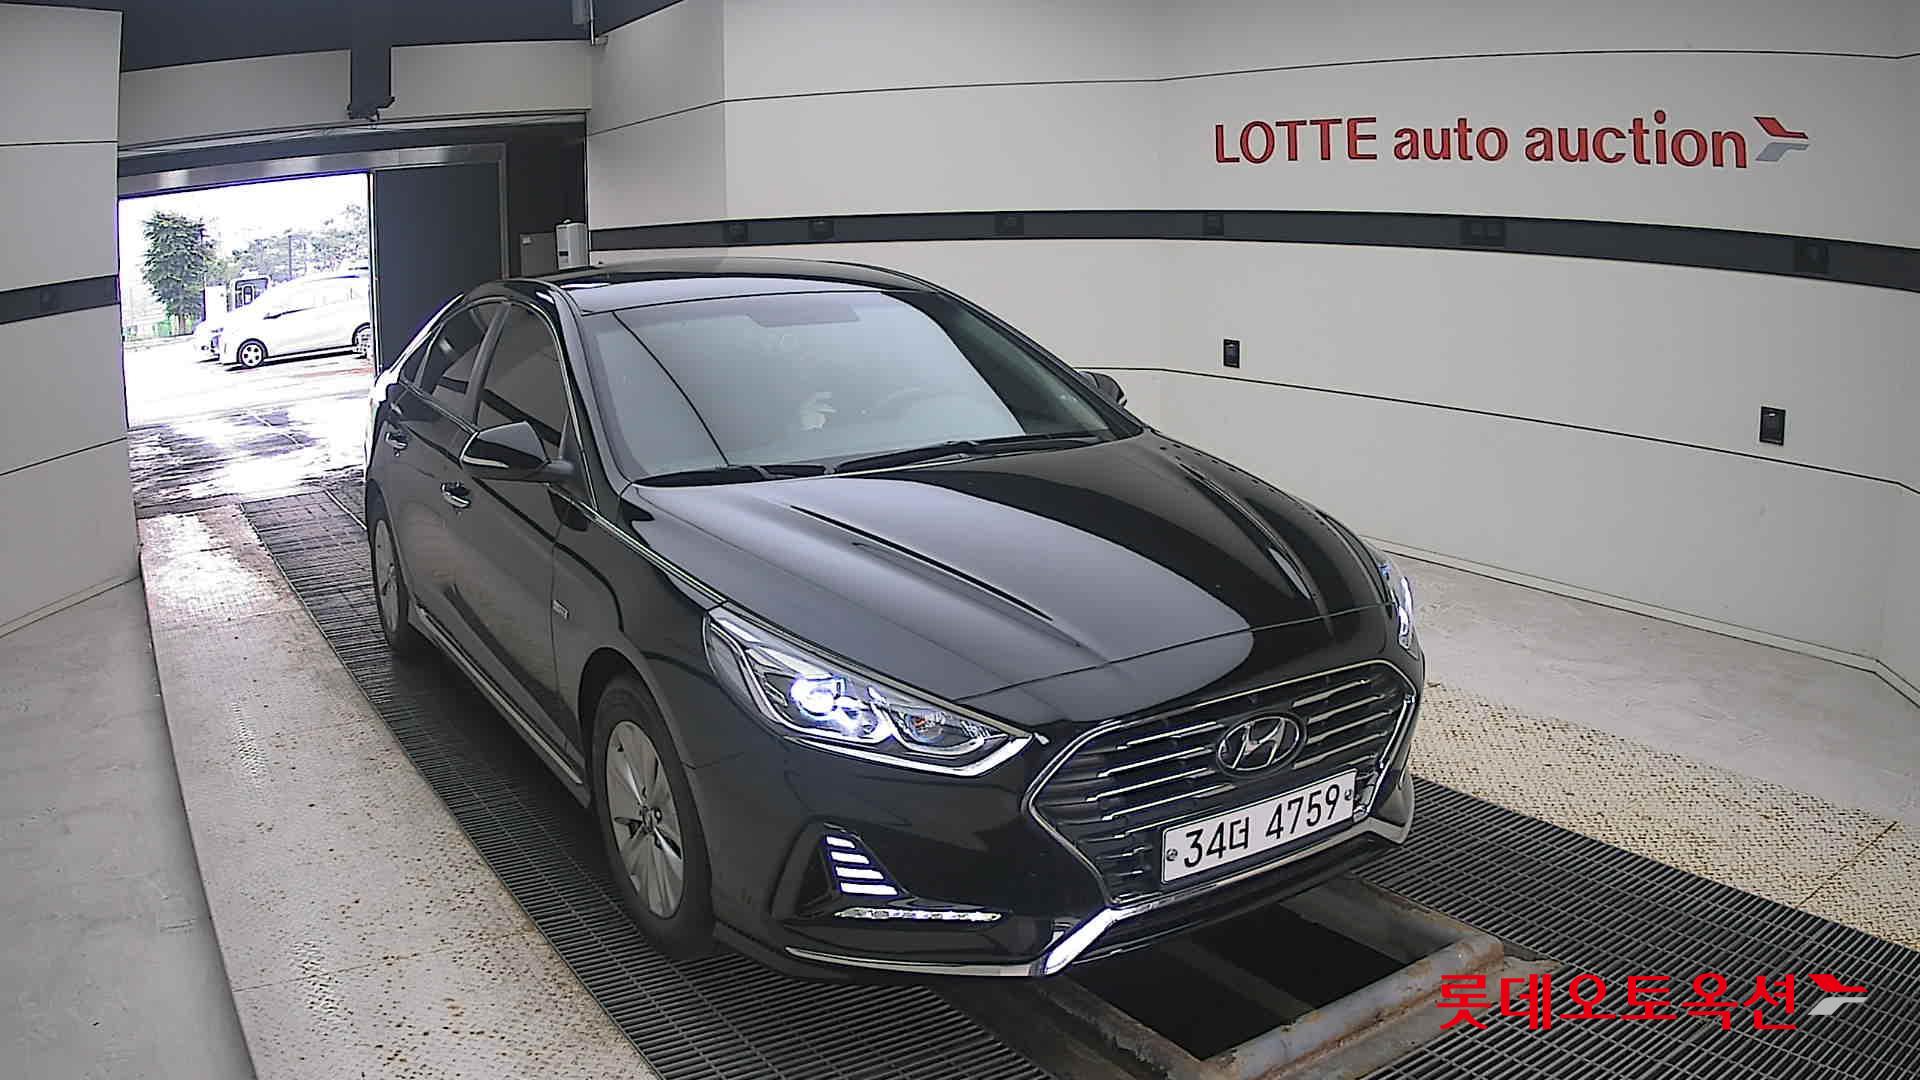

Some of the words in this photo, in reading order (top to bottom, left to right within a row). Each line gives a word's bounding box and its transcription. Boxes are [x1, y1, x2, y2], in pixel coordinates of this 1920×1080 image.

[1215, 117, 1377, 163] LOTTE
[1393, 118, 1509, 162] auto
[1524, 110, 1748, 168] auction
[1184, 816, 1249, 868] 34더
[1265, 784, 1340, 840] 4759
